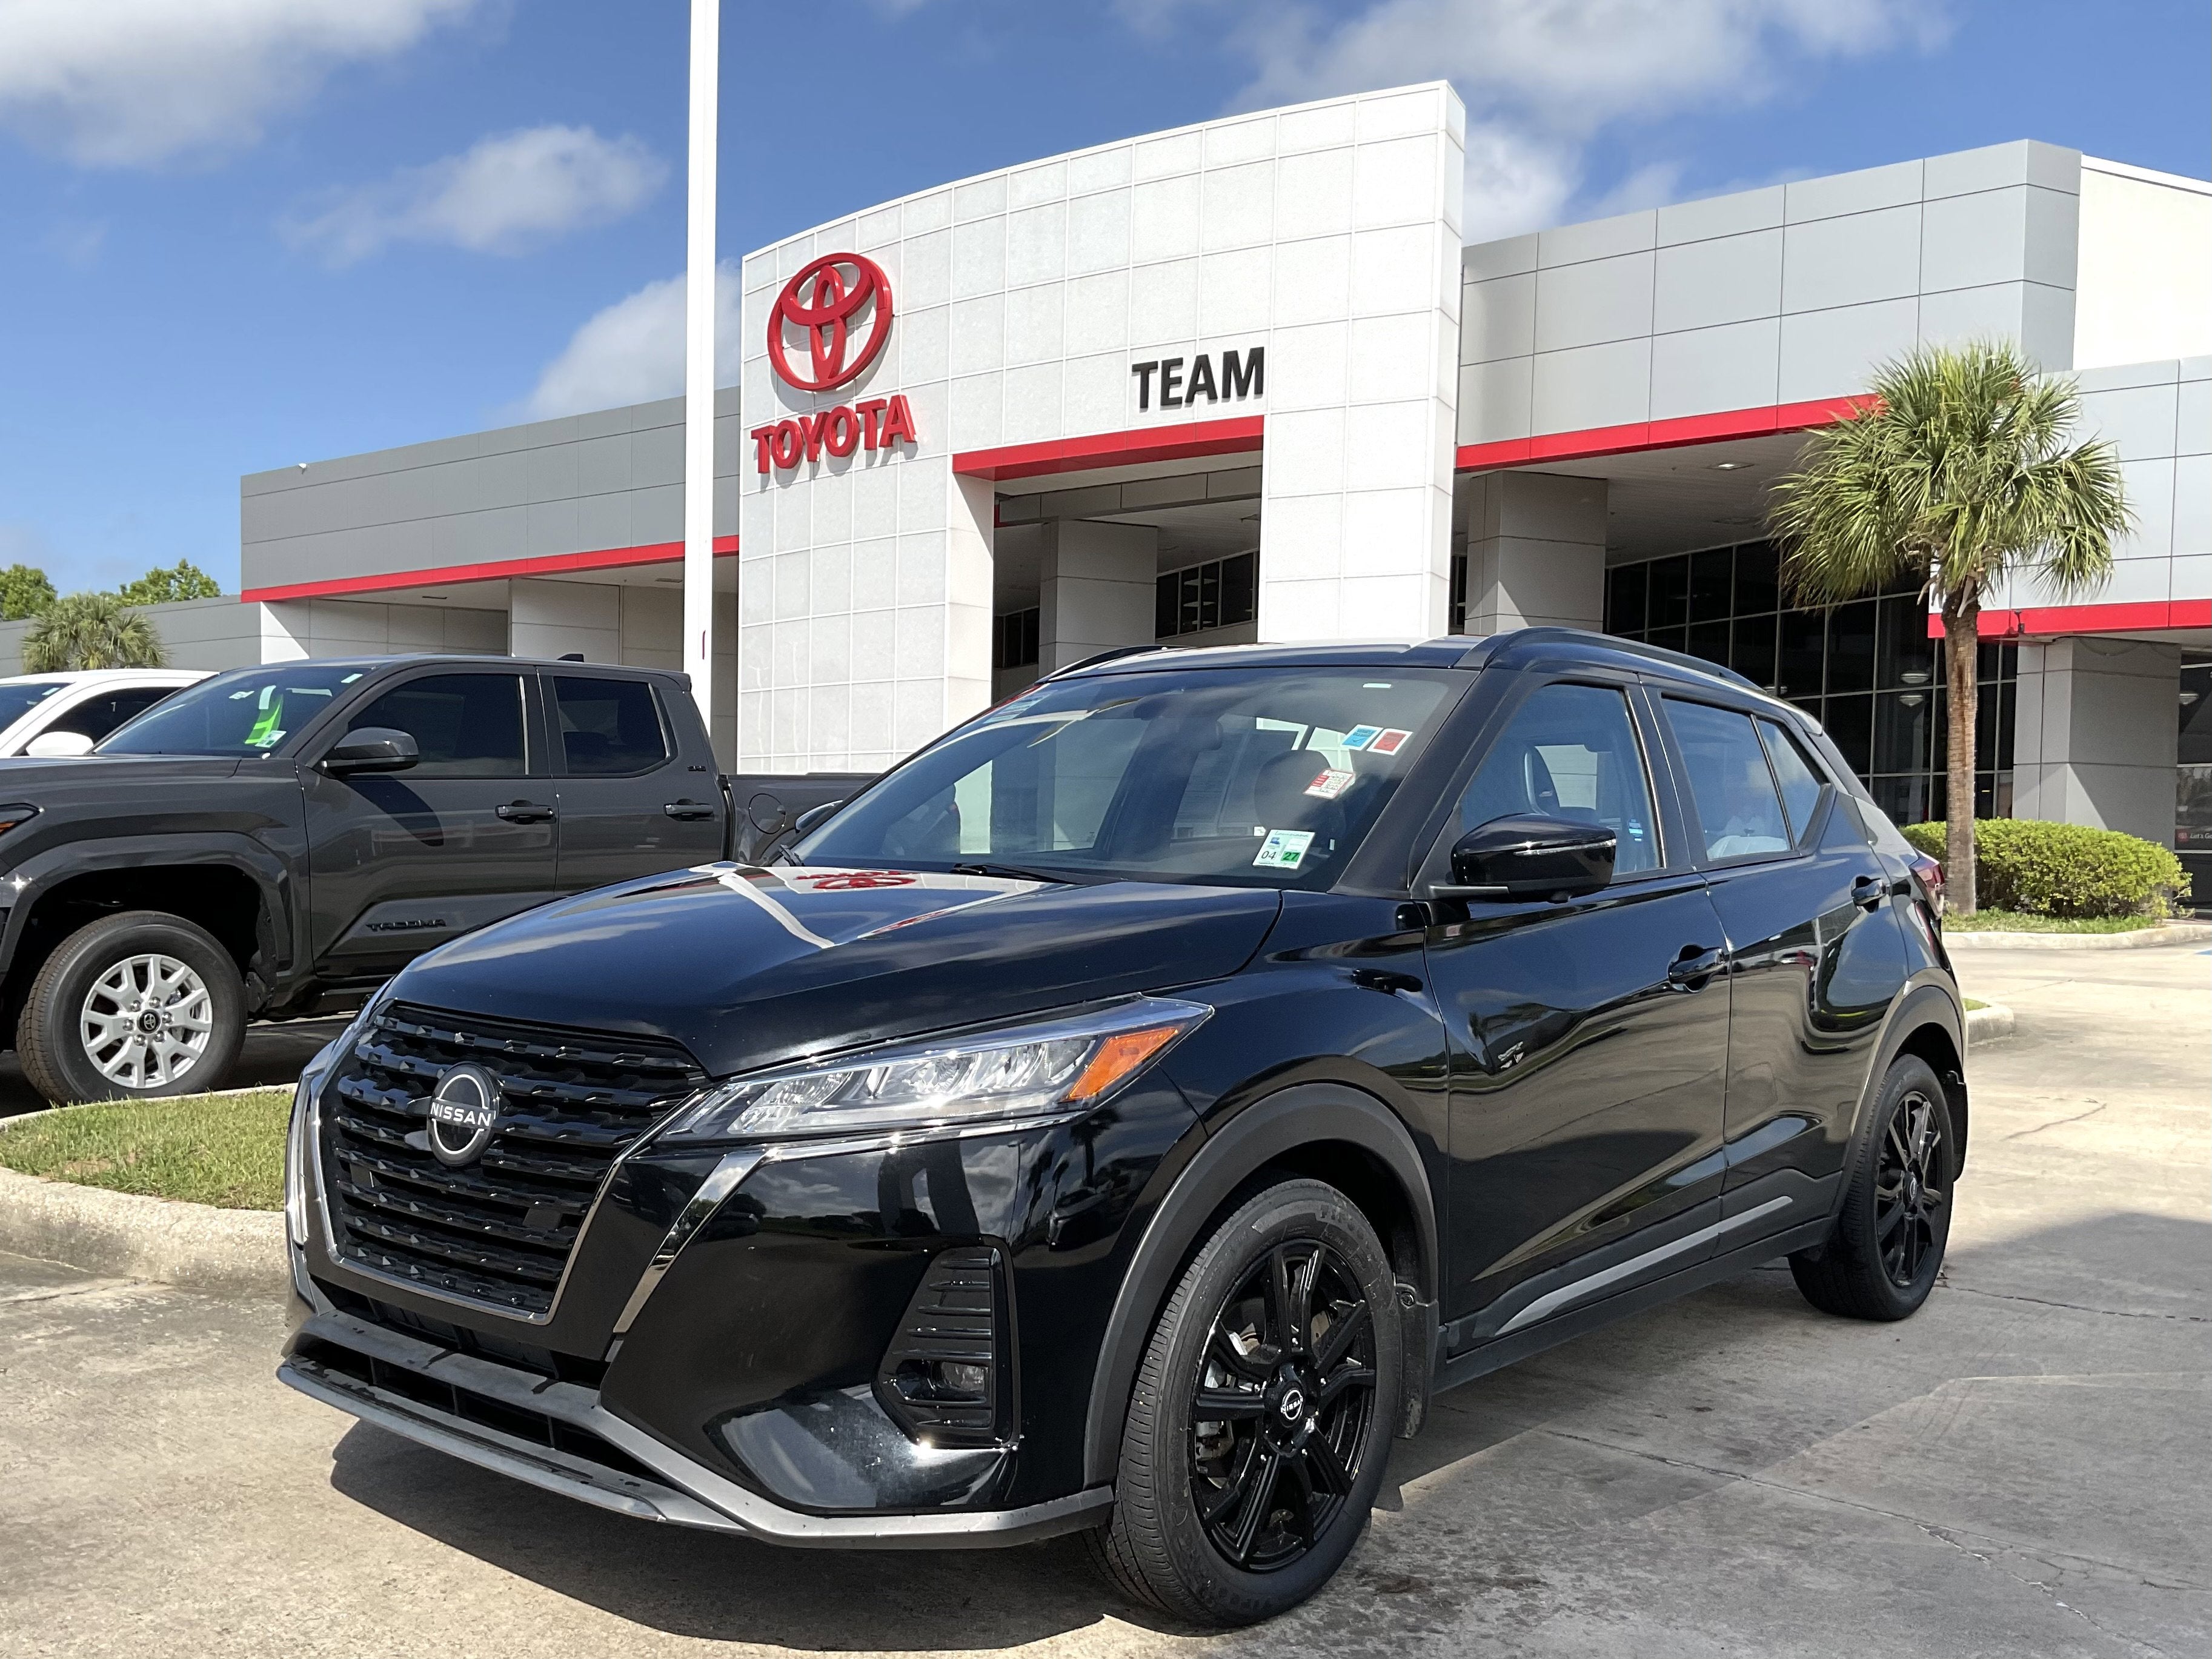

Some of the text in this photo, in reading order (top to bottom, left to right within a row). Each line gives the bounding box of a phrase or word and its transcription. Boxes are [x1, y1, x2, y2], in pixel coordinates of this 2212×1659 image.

[1132, 347, 1264, 409] TEAM
[751, 394, 917, 473] TOYOTA
[1261, 851, 1277, 860] 04
[1283, 852, 1300, 860] 27
[430, 1102, 491, 1126] NISSAN
